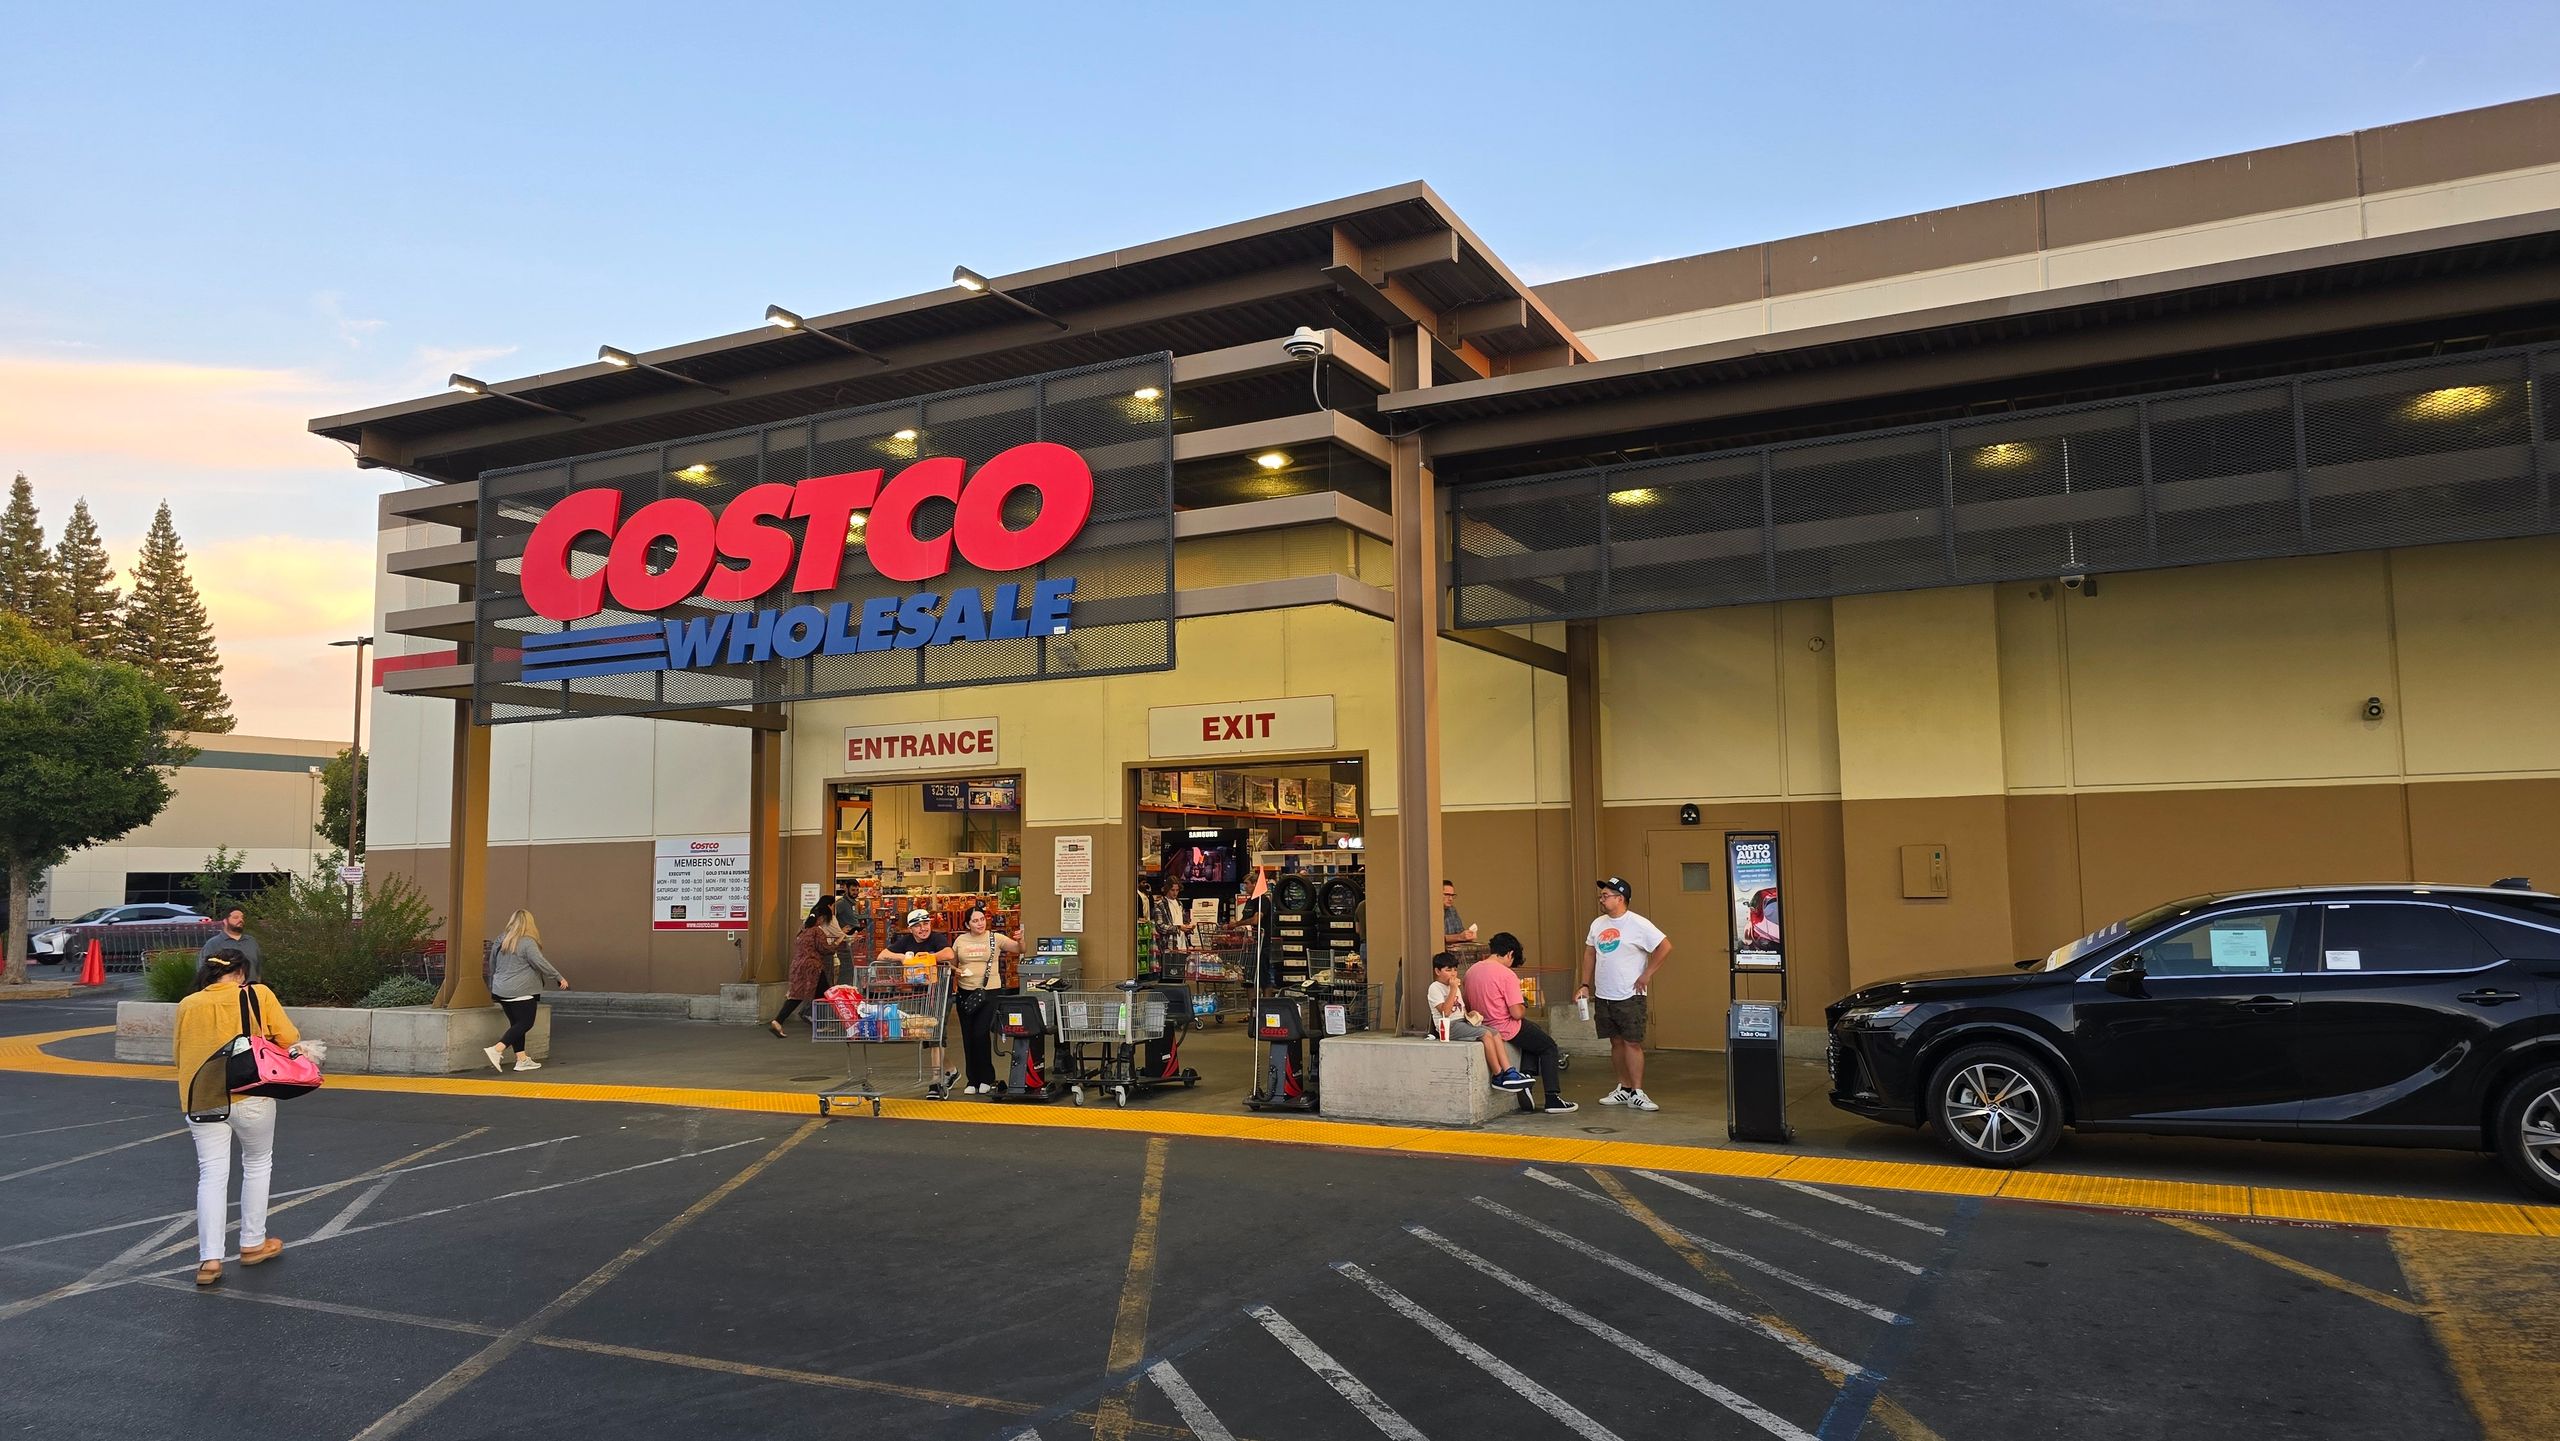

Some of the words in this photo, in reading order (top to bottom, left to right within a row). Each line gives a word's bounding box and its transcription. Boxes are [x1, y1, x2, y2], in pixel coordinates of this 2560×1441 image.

[520, 441, 1094, 621] COSTCO
[664, 577, 1077, 669] WHOLESALE
[1202, 712, 1276, 742] EXIT
[848, 729, 994, 761] ENTRANCE
[1735, 843, 1770, 851] COSTCO
[1736, 850, 1771, 860] AUTO
[674, 858, 713, 868] MEMBERS
[714, 857, 735, 866] ONLY
